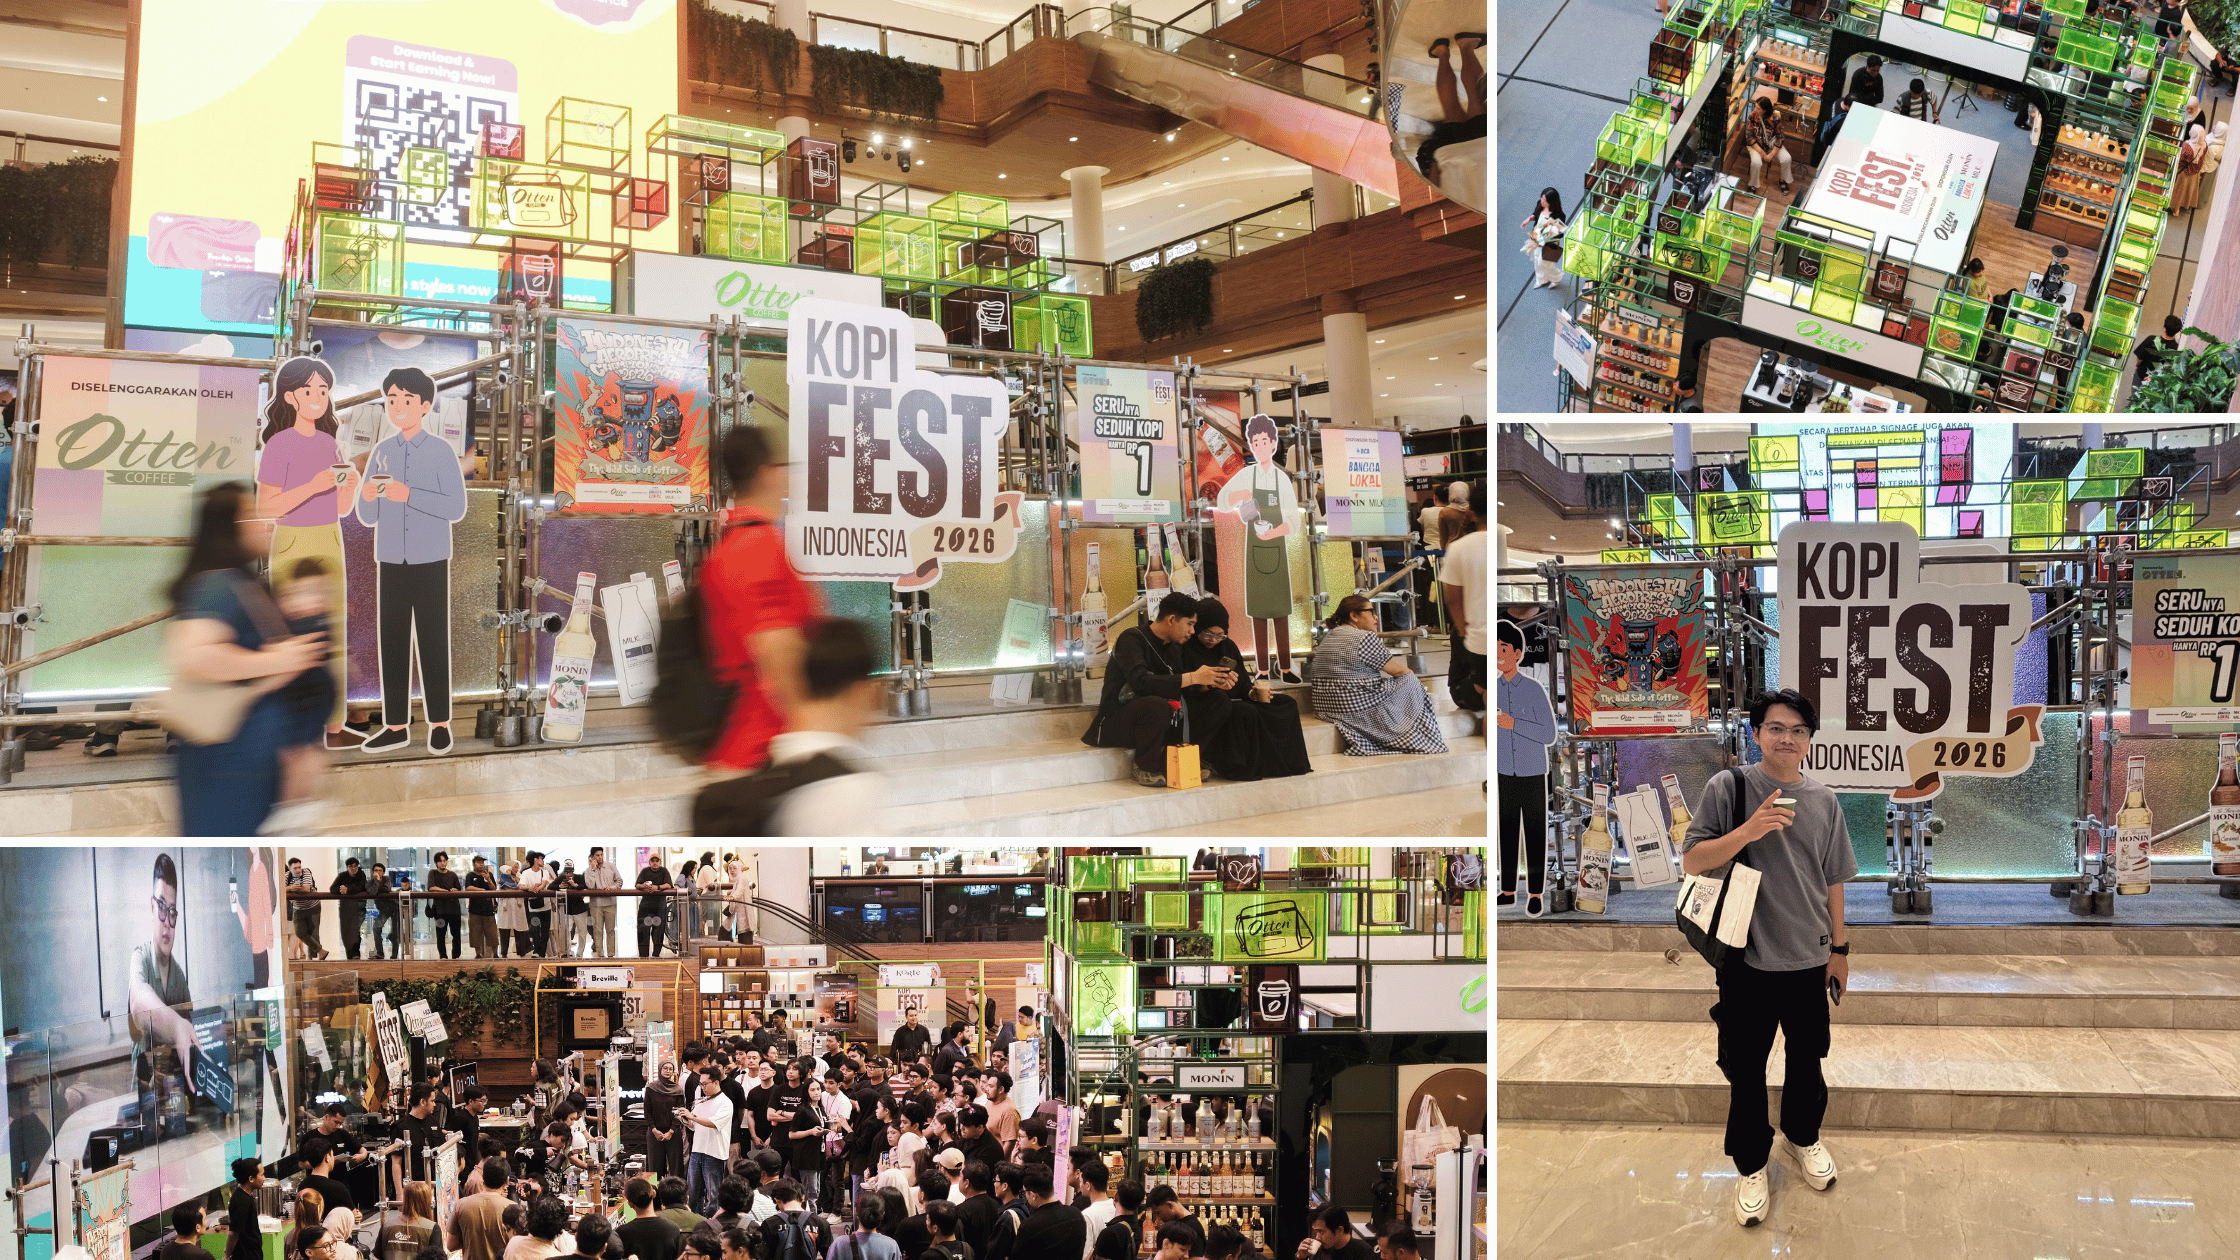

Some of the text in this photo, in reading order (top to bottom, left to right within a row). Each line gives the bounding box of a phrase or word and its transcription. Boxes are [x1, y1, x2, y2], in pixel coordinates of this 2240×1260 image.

[393, 45, 462, 66] Download
[370, 56, 496, 86] Start Earning Now!
[1827, 168, 1857, 197] KOPI
[1850, 151, 1913, 210] FEST
[511, 188, 555, 204] Otten
[1899, 187, 1920, 216] INDONESIA
[1934, 211, 1956, 241] Otten
[1174, 241, 1196, 256] Toast
[410, 277, 455, 298] styles
[457, 282, 491, 297] now
[752, 308, 780, 319] COFFEE
[1625, 311, 1652, 324] MONIN
[580, 329, 691, 359] INDONESIA
[1796, 319, 1864, 352] Otten
[806, 317, 898, 383] KOPI
[620, 368, 654, 382] 2026
[71, 381, 234, 399] DISELENGGARAKAN OLEH
[1095, 418, 1163, 438] SEDUH KOPI
[1880, 423, 1918, 432] SIGNAGE
[55, 412, 237, 471] Otten
[807, 381, 992, 519] FEST
[1108, 440, 1125, 449] HANYA
[588, 462, 679, 475] The Wild Side of Coffee
[1348, 461, 1380, 473] BANGGA
[125, 471, 175, 484] COFFEE
[1350, 474, 1381, 488] LOKAL
[1335, 498, 1365, 507] MONIN
[803, 525, 995, 558] INDONESIA 2026
[1797, 541, 1900, 600] KOPI
[1586, 577, 1688, 600] INDONESIA
[1601, 592, 1675, 609] AEROPRESS
[1596, 603, 1679, 620] CHAMPIONSHIP
[1622, 610, 1654, 622] 2026
[1084, 618, 1107, 626] MONIN
[2156, 616, 2213, 636] SEDUH
[2173, 642, 2198, 650] HANYA
[554, 664, 589, 675] MONIN
[1799, 603, 2010, 734] FEST
[1601, 693, 1679, 704] The Wild Side of Coffee
[1800, 741, 2006, 771] NDONESIA 2026
[2119, 834, 2149, 842] MONIN
[1583, 855, 1609, 863] MONIN
[1248, 920, 1290, 936] Otten
[1190, 1074, 1234, 1083] MONIN
